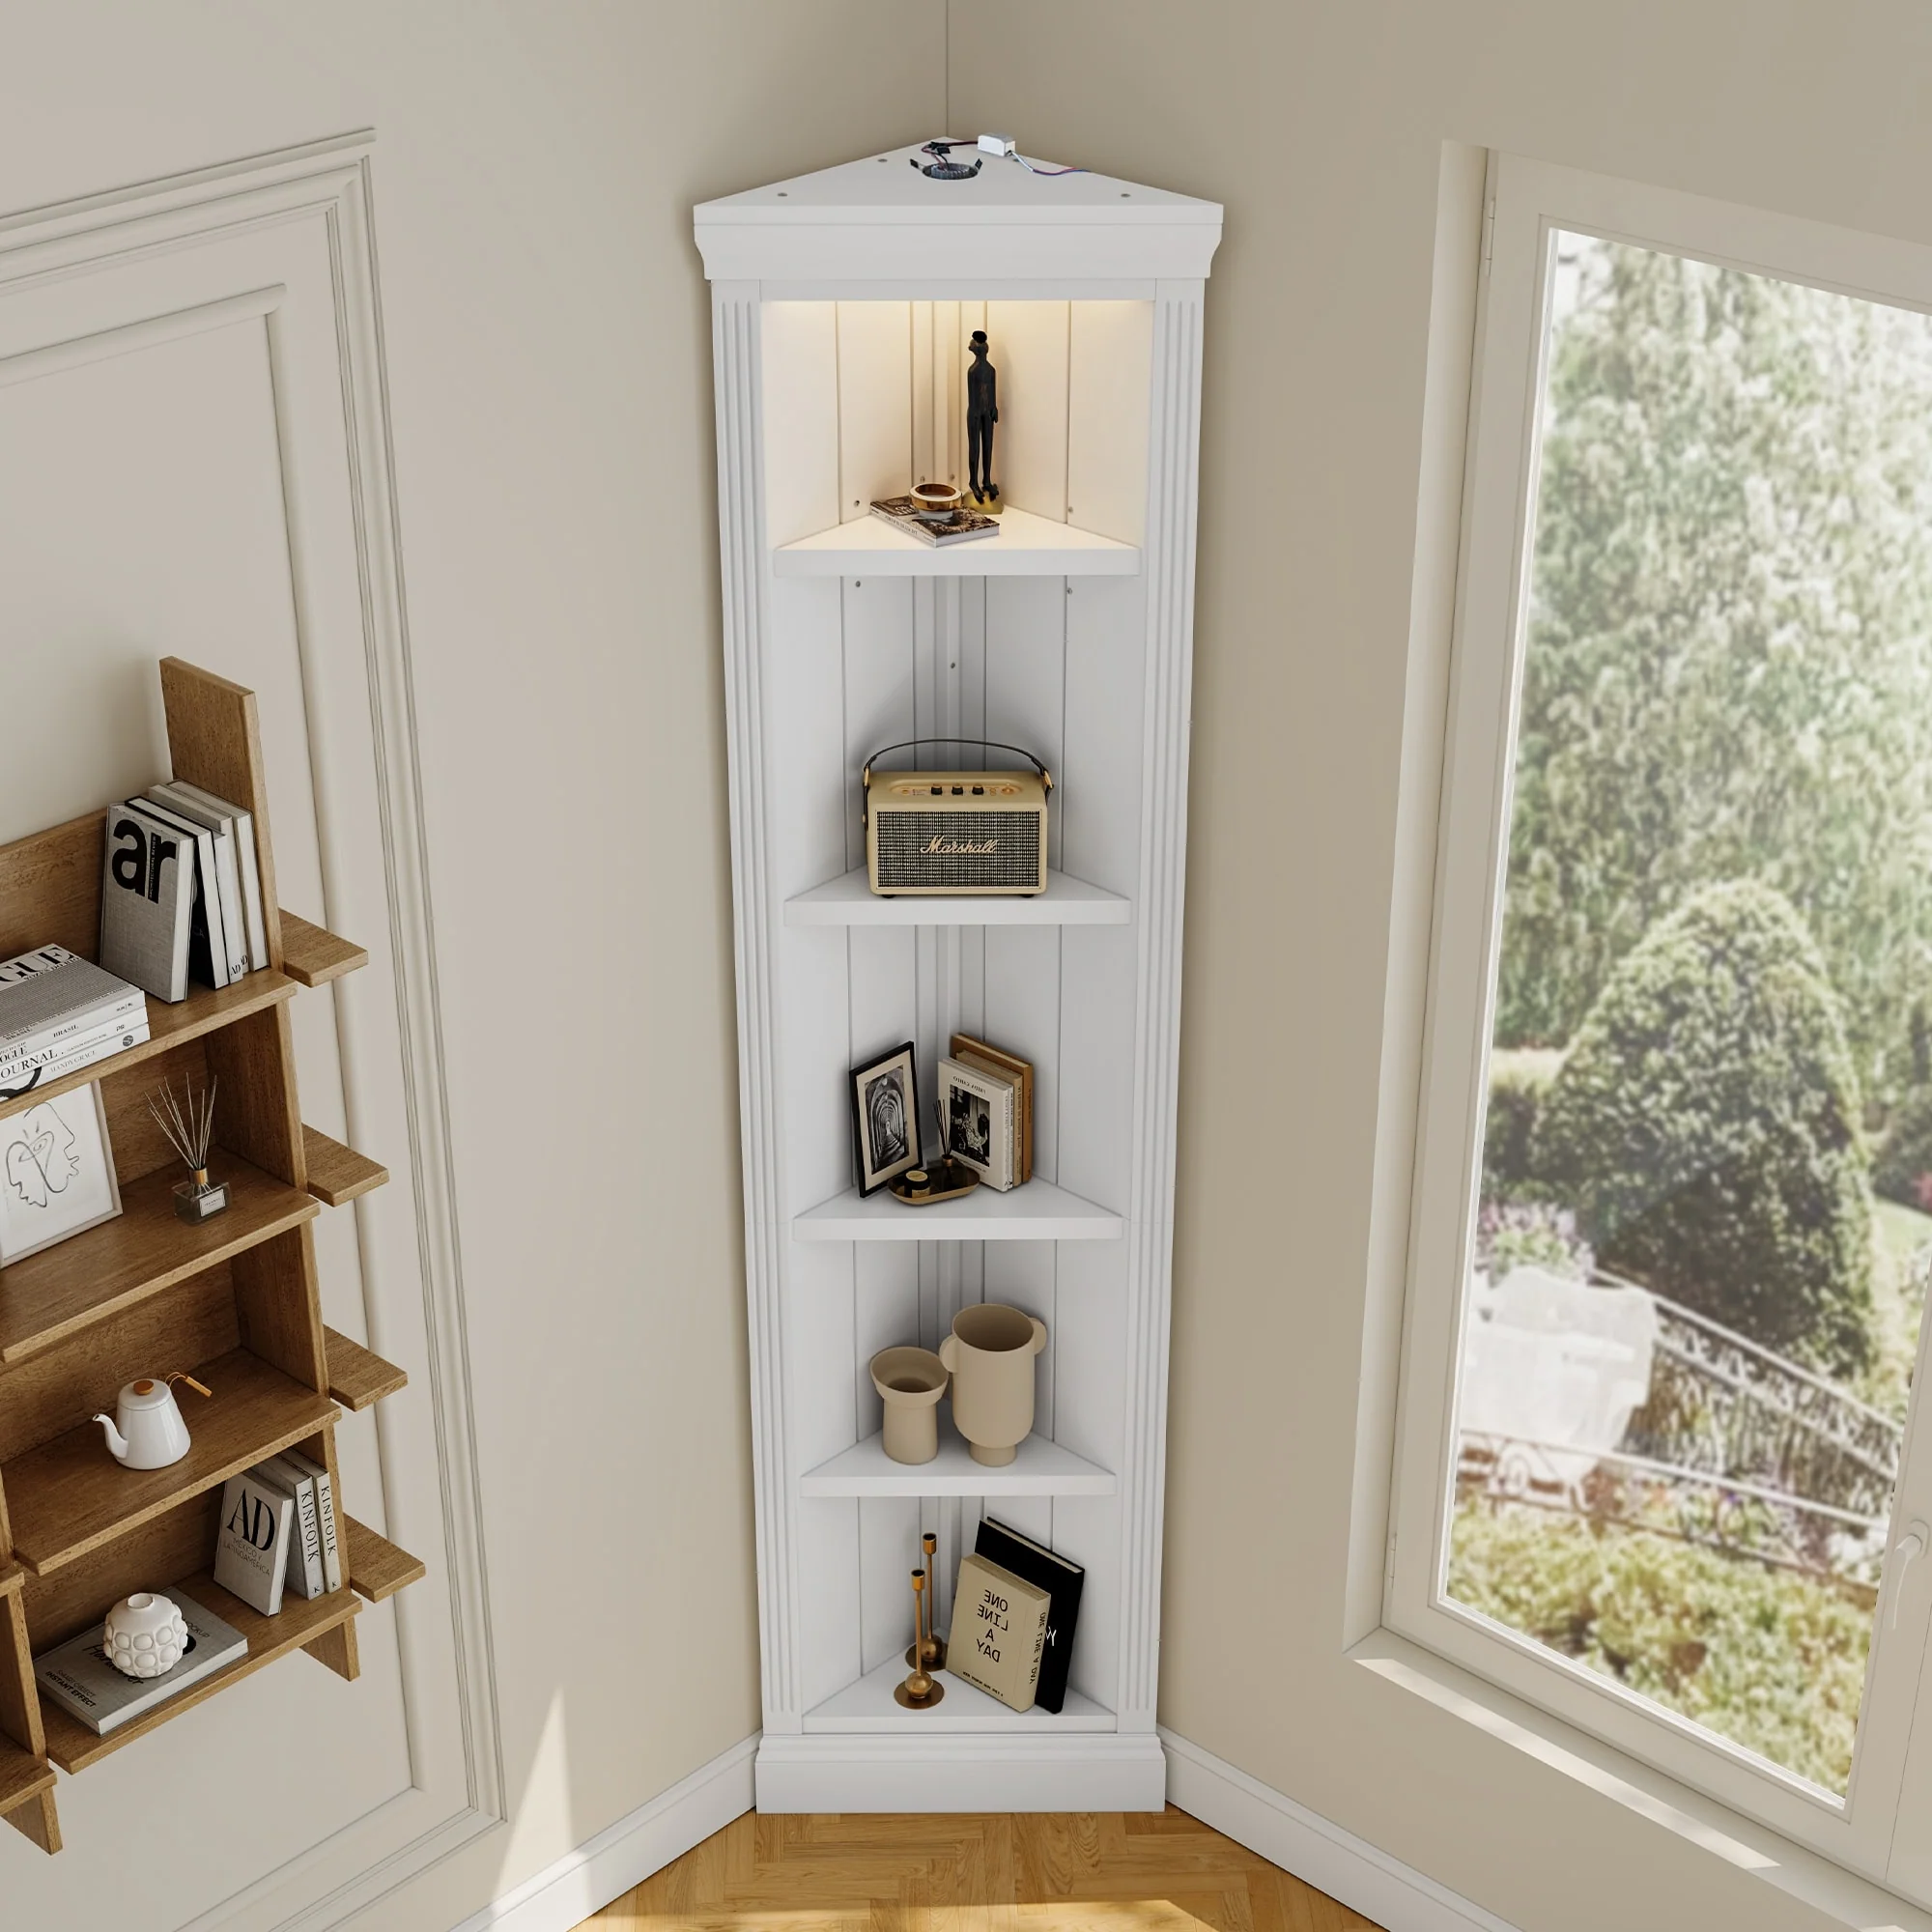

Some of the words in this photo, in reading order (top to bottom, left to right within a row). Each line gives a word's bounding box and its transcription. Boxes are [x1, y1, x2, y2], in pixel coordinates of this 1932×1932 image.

[111, 819, 177, 904] ar
[920, 835, 999, 854] Marshall
[226, 1489, 275, 1551] AD
[301, 1491, 320, 1563] KINFOLK
[321, 1486, 336, 1556] KINFOLK
[183, 1618, 210, 1638] OCKUP
[44, 1671, 74, 1691] INSTANT
[71, 1690, 97, 1707] EFFECT
